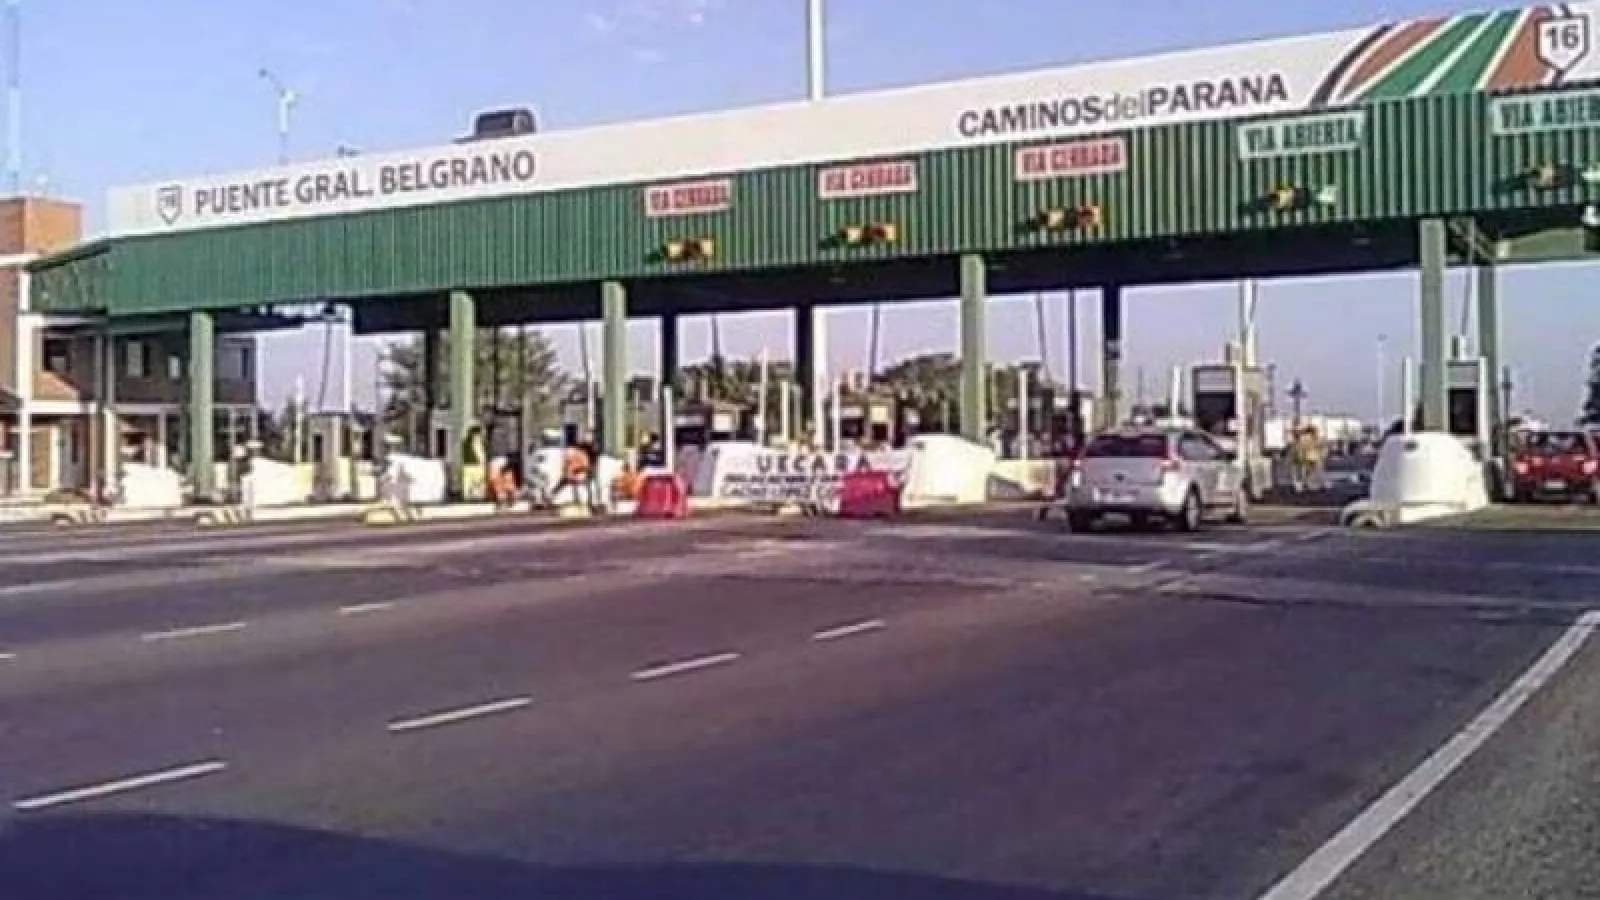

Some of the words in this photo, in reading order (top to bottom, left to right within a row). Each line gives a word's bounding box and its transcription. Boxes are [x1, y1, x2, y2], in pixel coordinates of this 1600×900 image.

[1545, 24, 1579, 50] 16
[195, 179, 288, 214] PUENTE
[296, 168, 374, 203] GRAL.
[380, 150, 536, 195] BELGRANO
